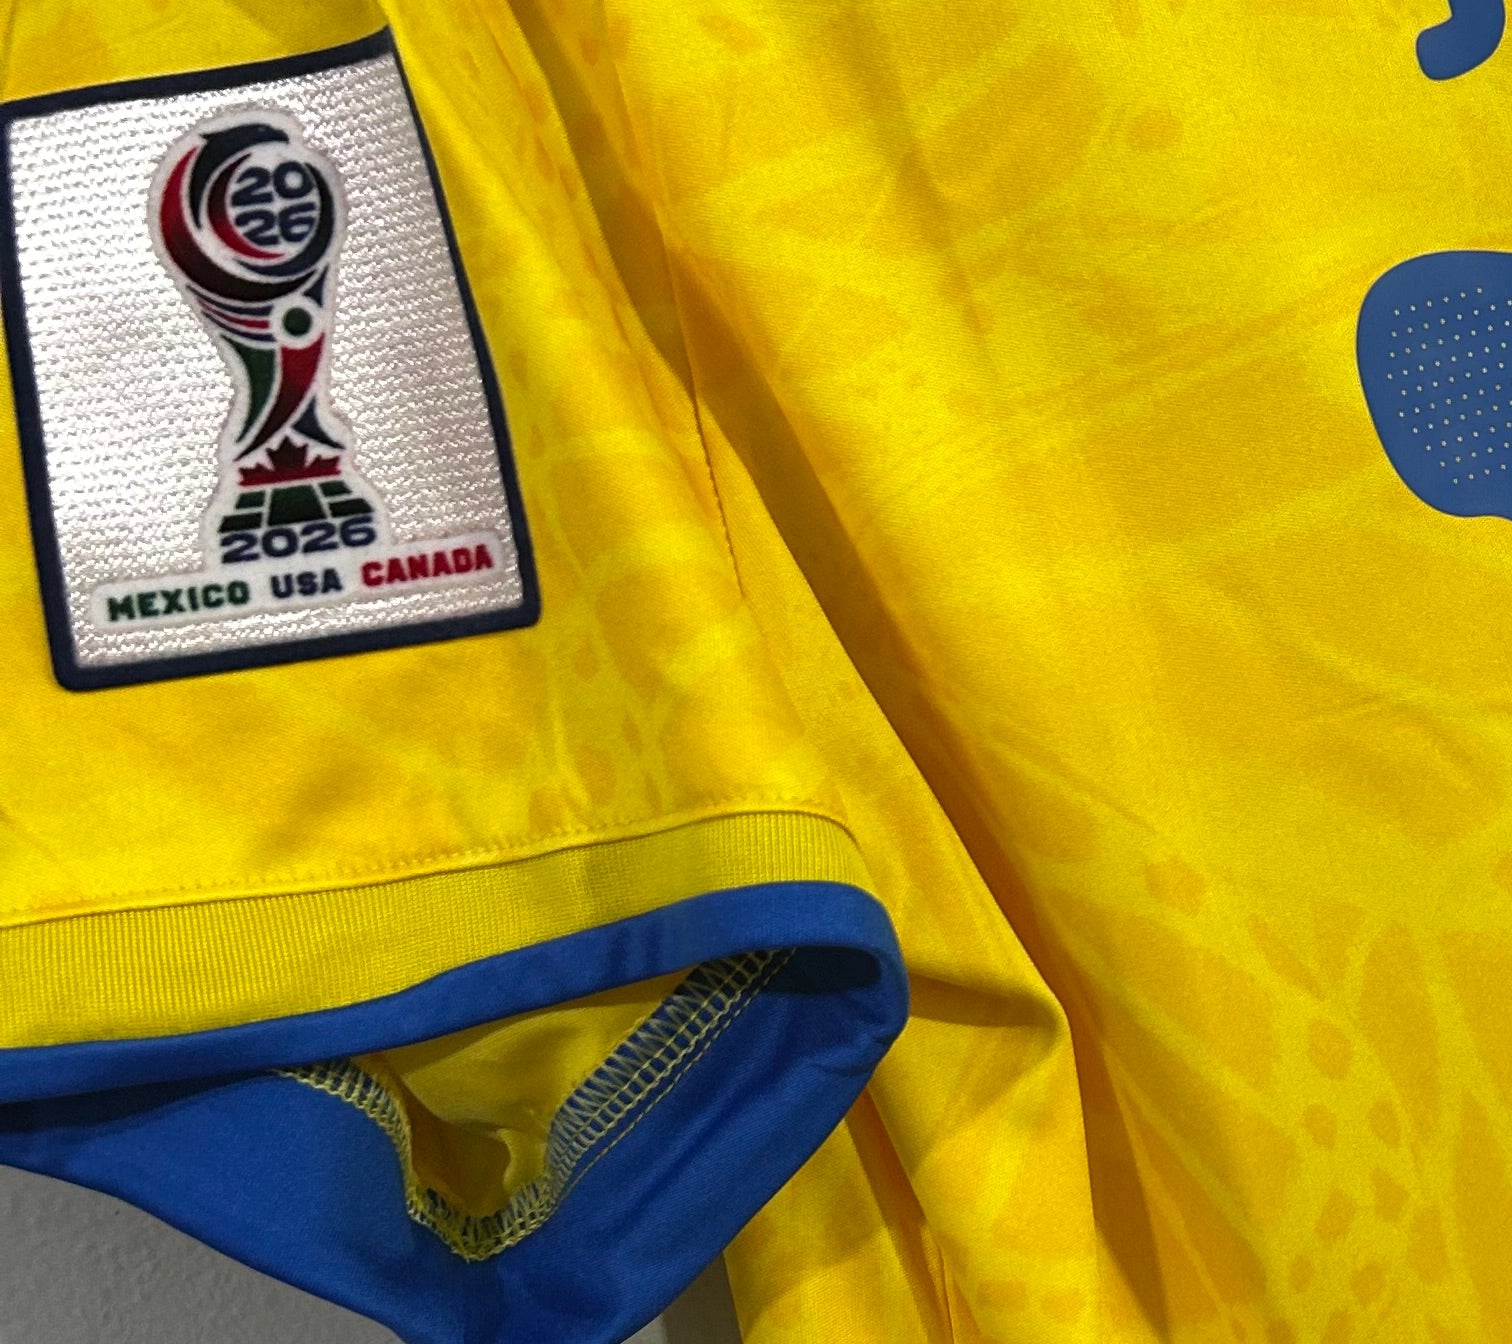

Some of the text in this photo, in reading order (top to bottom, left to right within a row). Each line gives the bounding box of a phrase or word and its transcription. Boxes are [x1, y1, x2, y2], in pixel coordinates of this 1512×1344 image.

[231, 160, 316, 207] 20
[234, 202, 317, 246] 26
[218, 514, 377, 564] 2026
[106, 543, 494, 622] MEXICO USA CANADA
